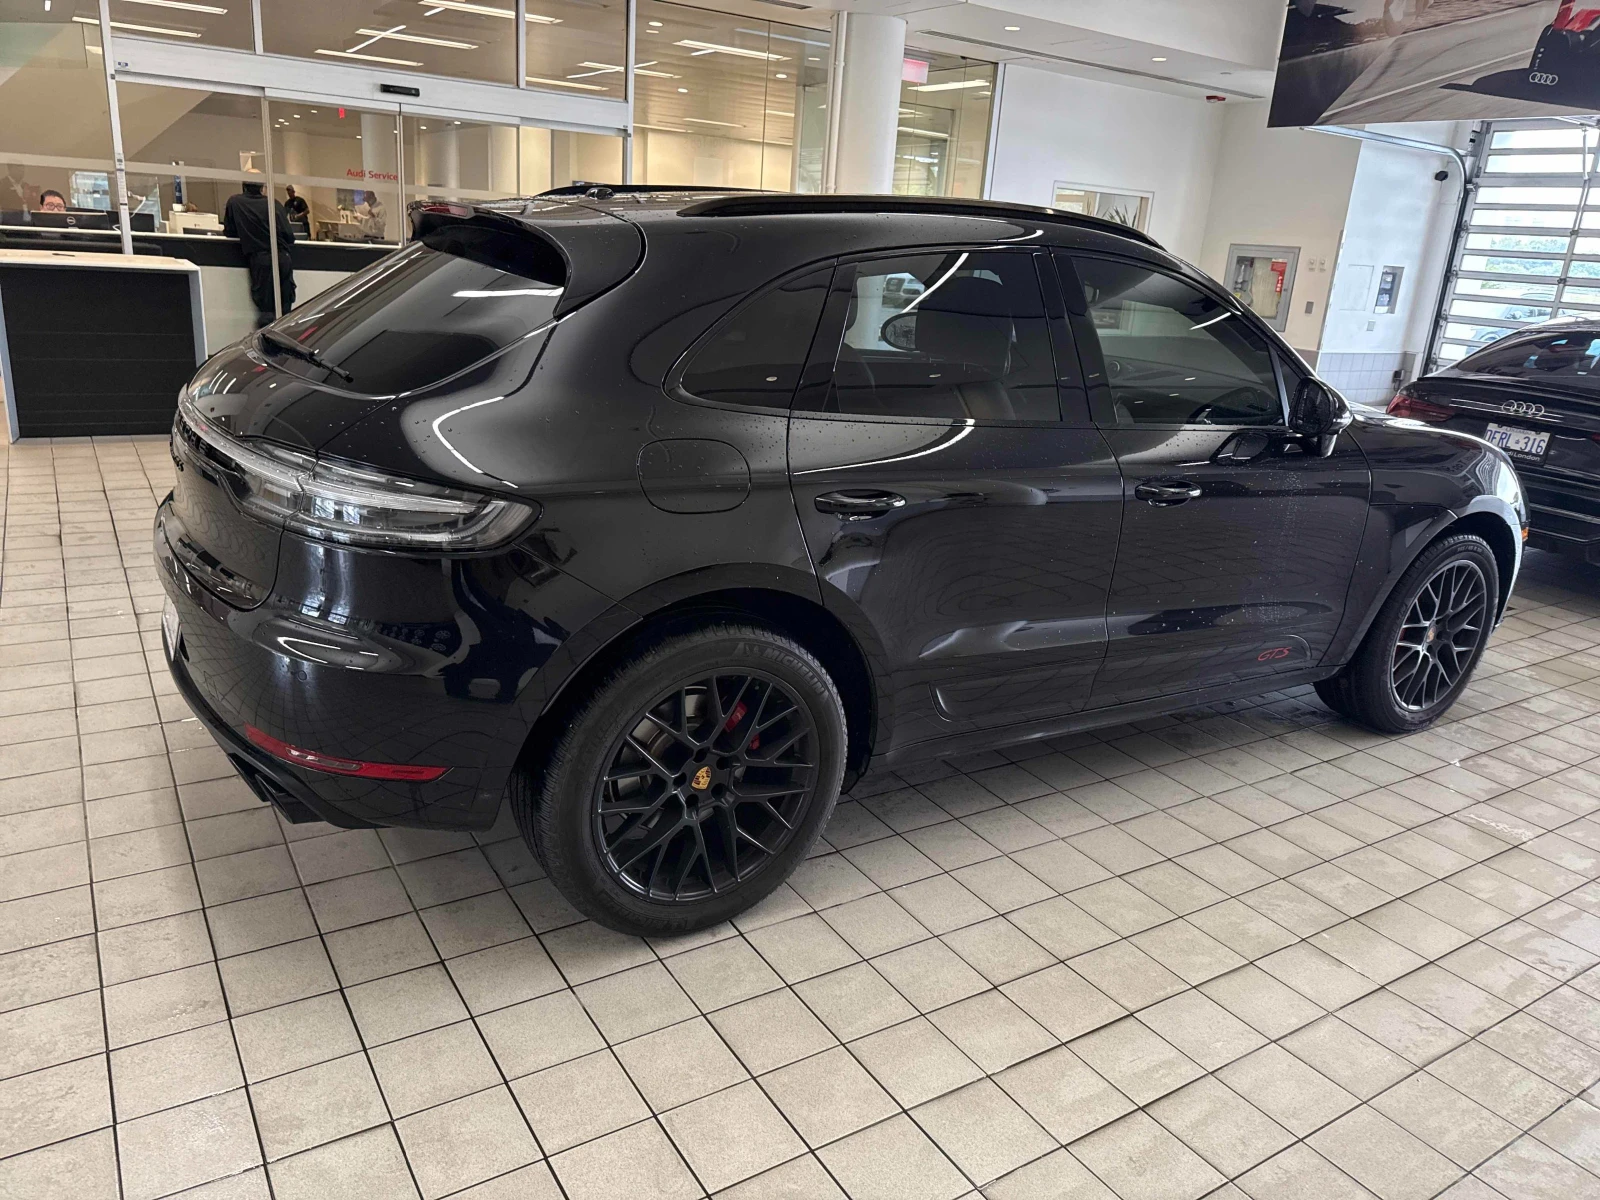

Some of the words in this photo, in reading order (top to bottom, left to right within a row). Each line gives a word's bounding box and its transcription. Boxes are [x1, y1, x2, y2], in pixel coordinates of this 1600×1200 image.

[346, 168, 366, 178] Audi
[368, 170, 398, 181] Service
[1520, 435, 1546, 454] 316
[1513, 451, 1540, 462] London
[1257, 646, 1292, 661] GTS
[763, 649, 827, 695] MICHELIN
